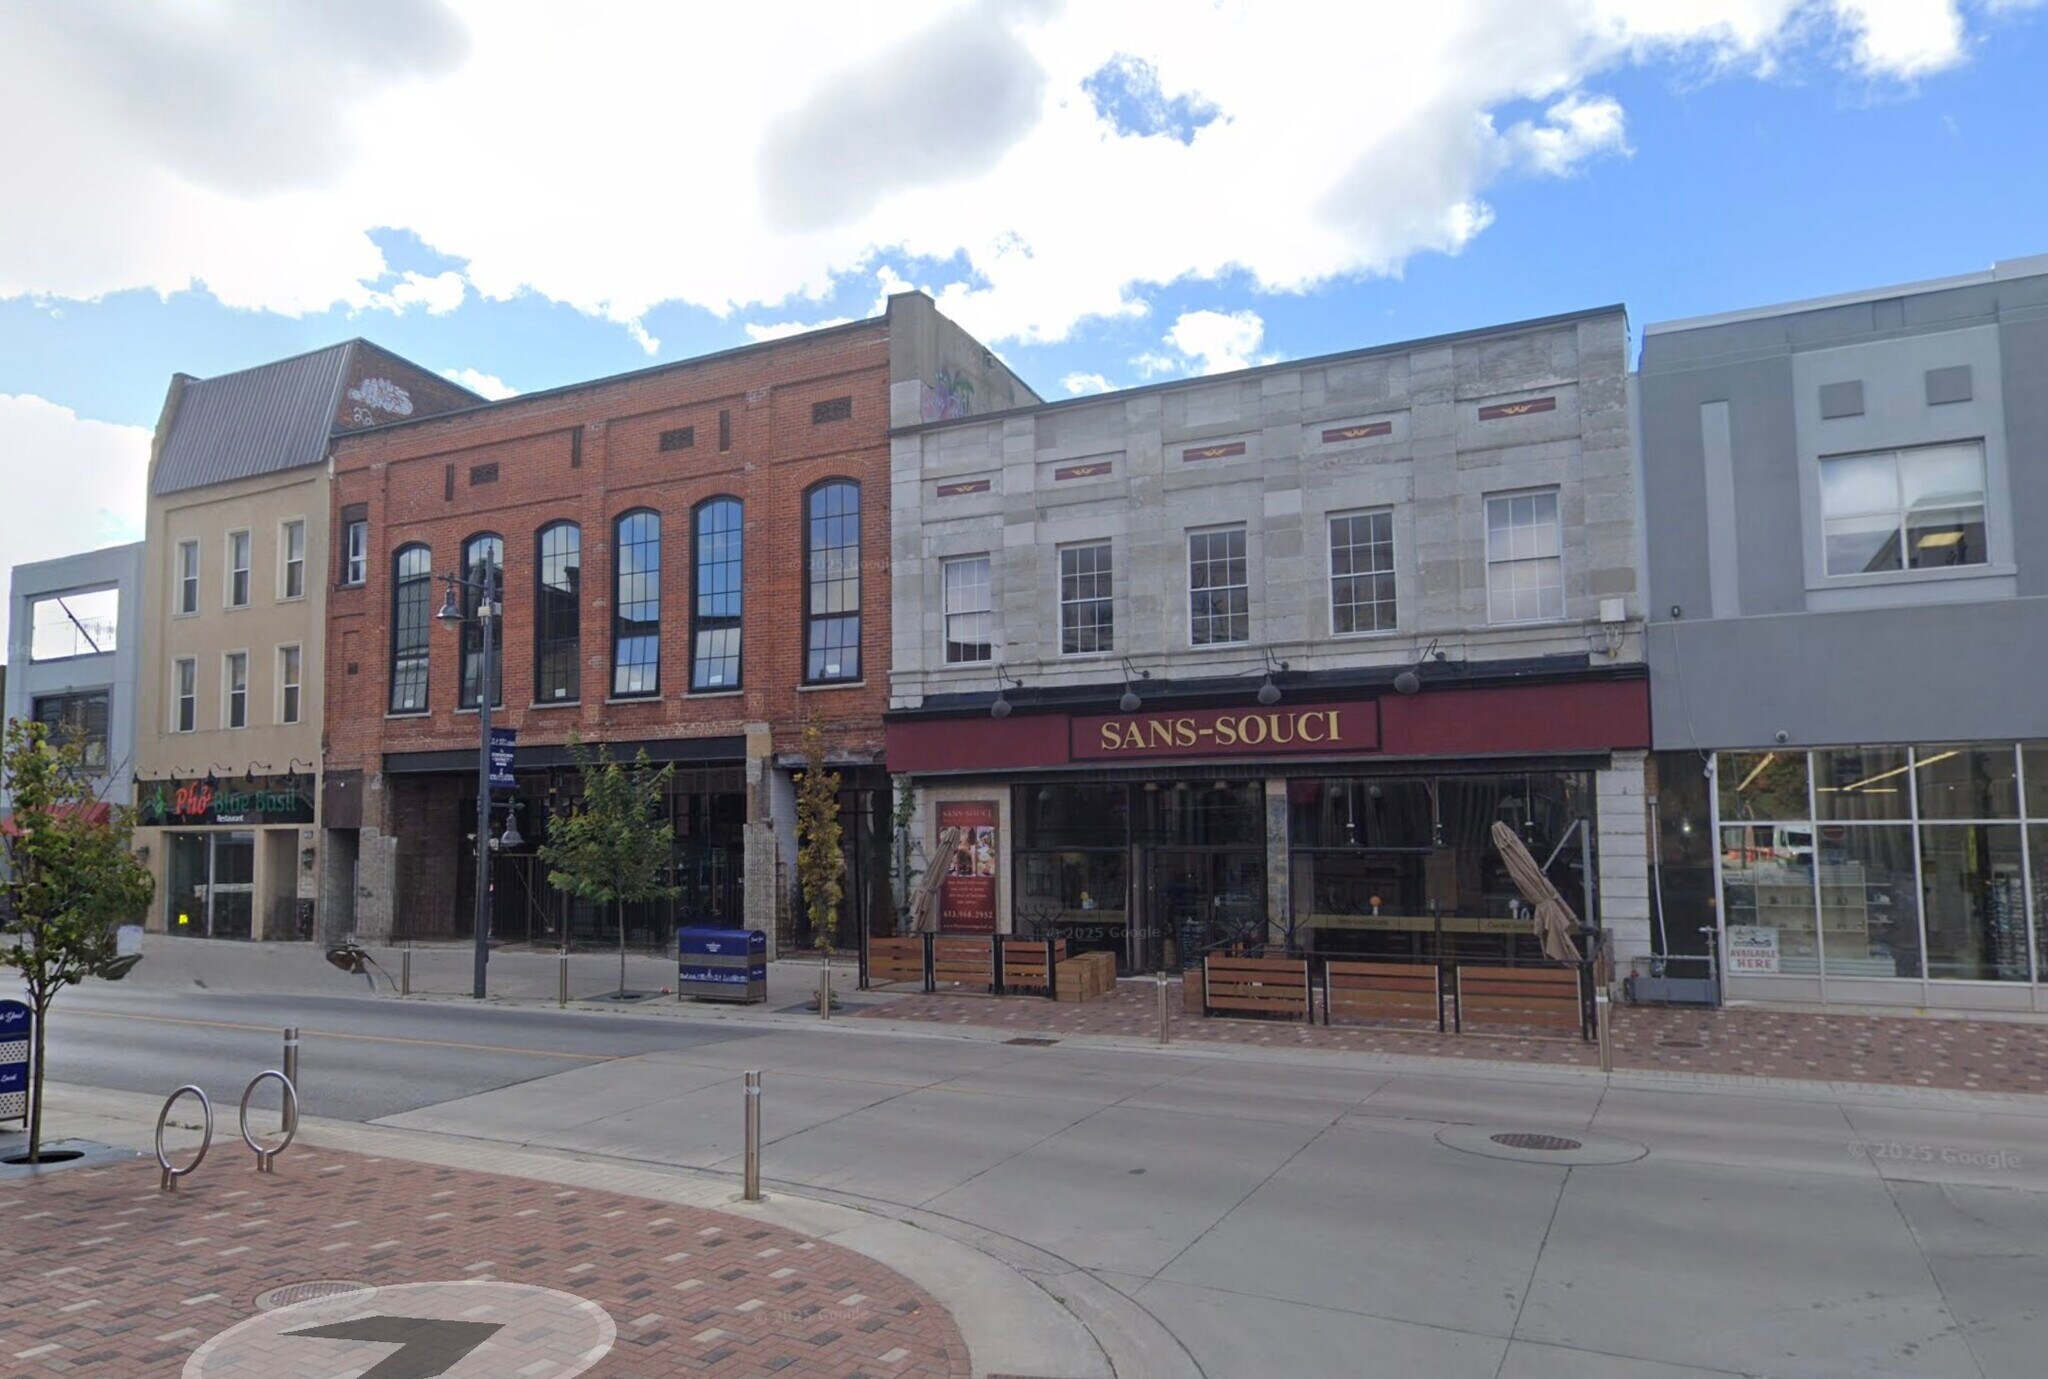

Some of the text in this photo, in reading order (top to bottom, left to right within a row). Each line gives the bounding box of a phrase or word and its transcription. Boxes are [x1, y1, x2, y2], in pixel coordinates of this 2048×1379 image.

[1101, 710, 1342, 750] SANS-SOUCI
[213, 790, 251, 813] Blue
[255, 787, 298, 812] Basil
[216, 814, 244, 823] Restaurant
[1730, 949, 1776, 959] AVAILABLE
[1737, 958, 1771, 969] HERE
